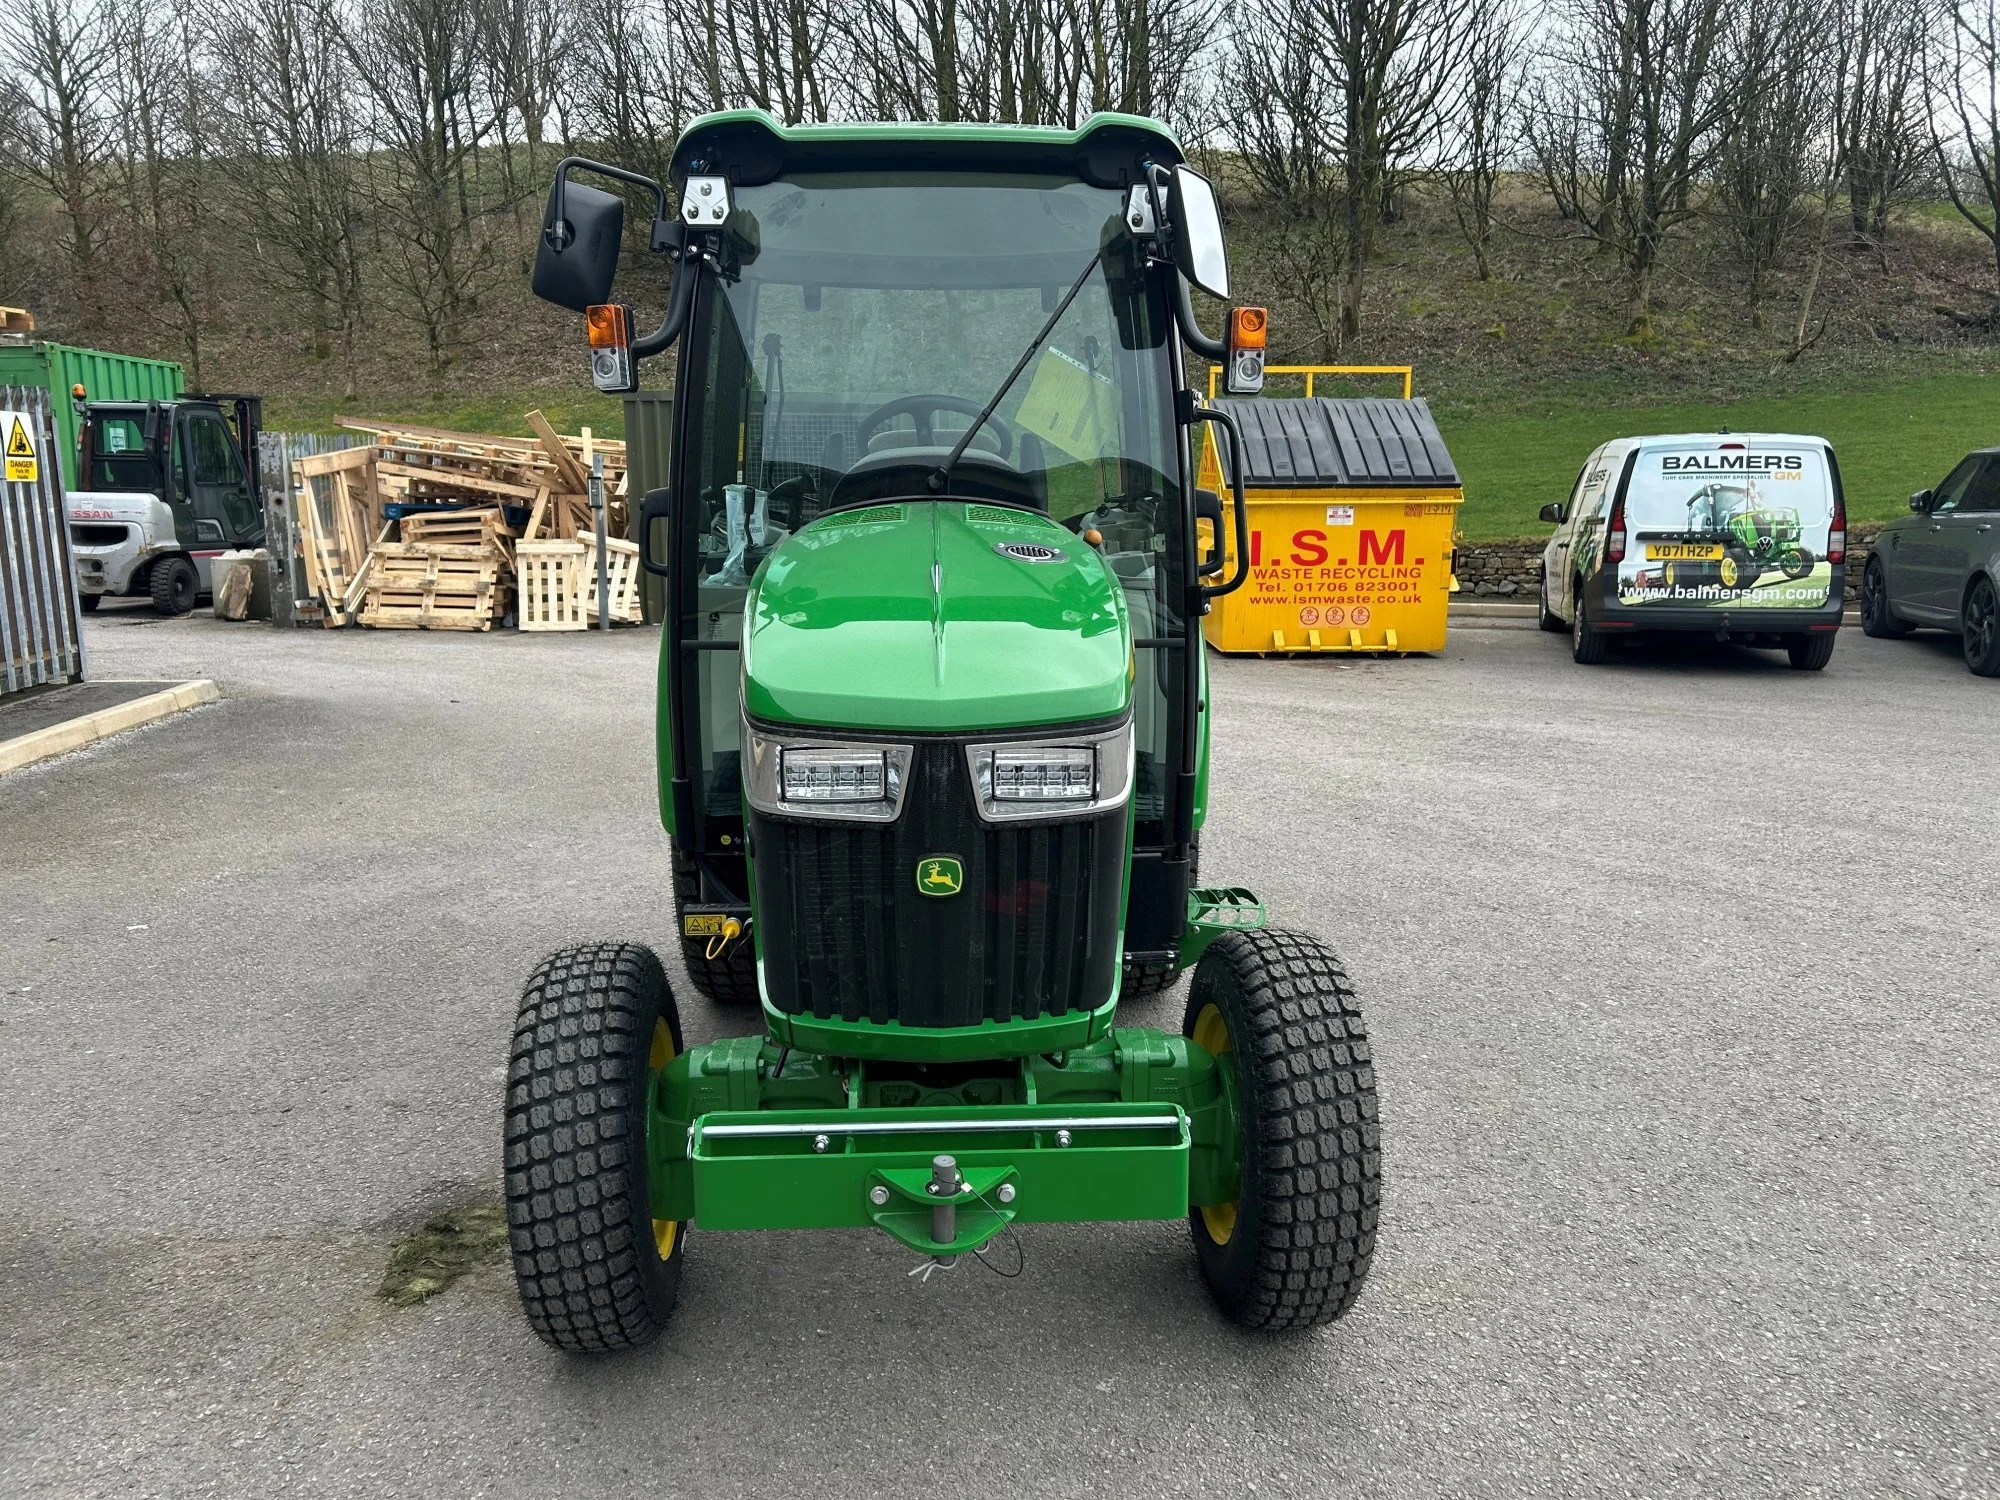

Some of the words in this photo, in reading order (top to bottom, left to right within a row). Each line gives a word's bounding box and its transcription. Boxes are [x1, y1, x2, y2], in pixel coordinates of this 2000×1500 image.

[10, 460, 33, 468] DANGER
[1662, 455, 1802, 470] BALMERS
[1774, 472, 1802, 480] GM
[1250, 529, 1425, 567] I.S.M.
[1654, 545, 1684, 557] YD71
[1687, 545, 1714, 557] HZP
[1253, 568, 1314, 580] WASTE
[1320, 567, 1422, 579] RECYCLING
[1256, 582, 1286, 592] Tel.
[1294, 582, 1348, 592] 01706
[1355, 581, 1418, 592] 823001
[1249, 594, 1422, 604] www.ismwaste.co.uk
[1624, 584, 1823, 602] www.balmersgm.com
